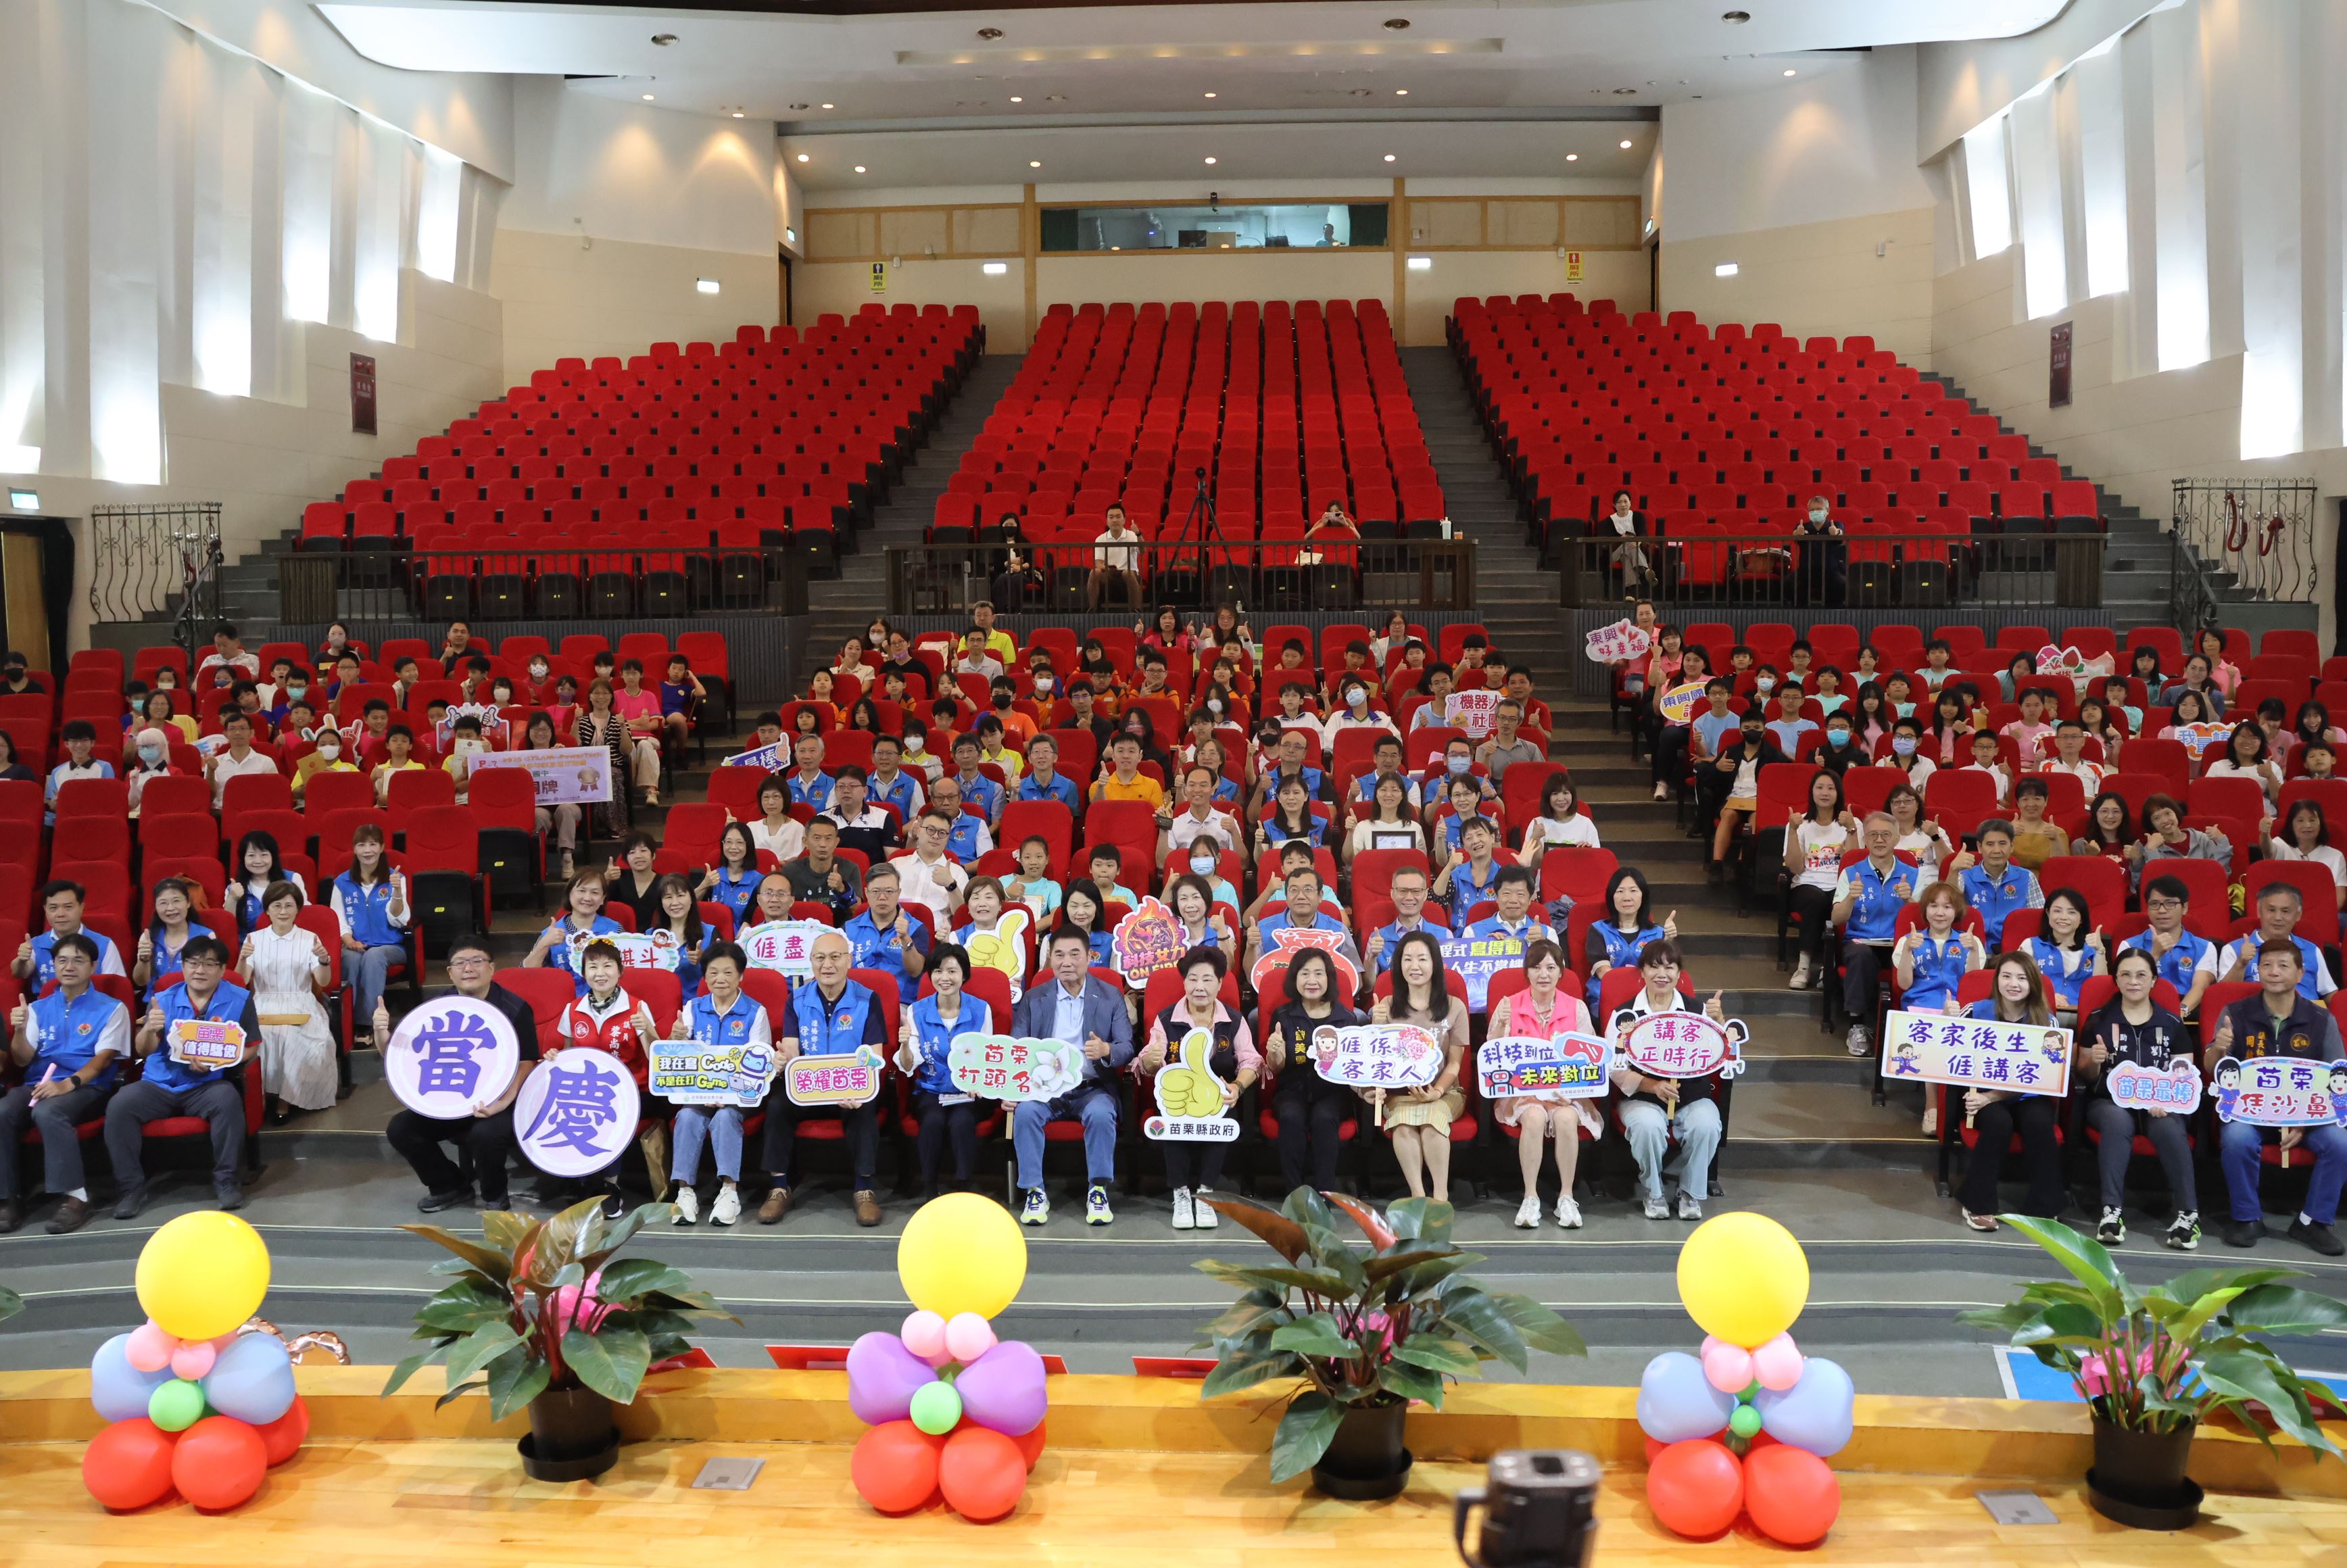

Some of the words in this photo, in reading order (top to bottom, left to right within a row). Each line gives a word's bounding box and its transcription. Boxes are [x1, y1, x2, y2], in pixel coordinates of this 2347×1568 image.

[1590, 628, 1618, 645] 東興
[1599, 639, 1645, 656] 好幸福
[1460, 694, 1499, 710] 機器人
[1806, 858, 1839, 868] Hakka
[1123, 945, 1186, 969] 科技女力
[1470, 939, 1522, 956] 寫得動
[1130, 966, 1150, 979] ON
[196, 1025, 224, 1041] 苗栗
[1653, 1020, 1701, 1043] 講客
[1908, 1019, 2030, 1052] 客家後生
[183, 1041, 237, 1059] 值得驕傲
[412, 1010, 497, 1099] 當
[985, 1044, 1028, 1065] 苗栗
[1483, 1042, 1556, 1064] 科技到位
[1639, 1046, 1712, 1069] 正時行
[658, 1056, 698, 1071] 我在寫
[701, 1055, 736, 1073] Code
[1341, 1059, 1423, 1081] 客家人
[1520, 1064, 1599, 1086] 未來對位
[656, 1075, 696, 1087] 不是在打
[696, 1075, 728, 1090] Game
[794, 1066, 868, 1094] 榮耀苗栗
[958, 1066, 1032, 1094] 打頭名
[2256, 1067, 2313, 1091] 苗栗
[2117, 1077, 2194, 1104] 苗栗最棒
[522, 1060, 621, 1157] 慶
[1170, 1123, 1234, 1137] 苗栗縣政府
